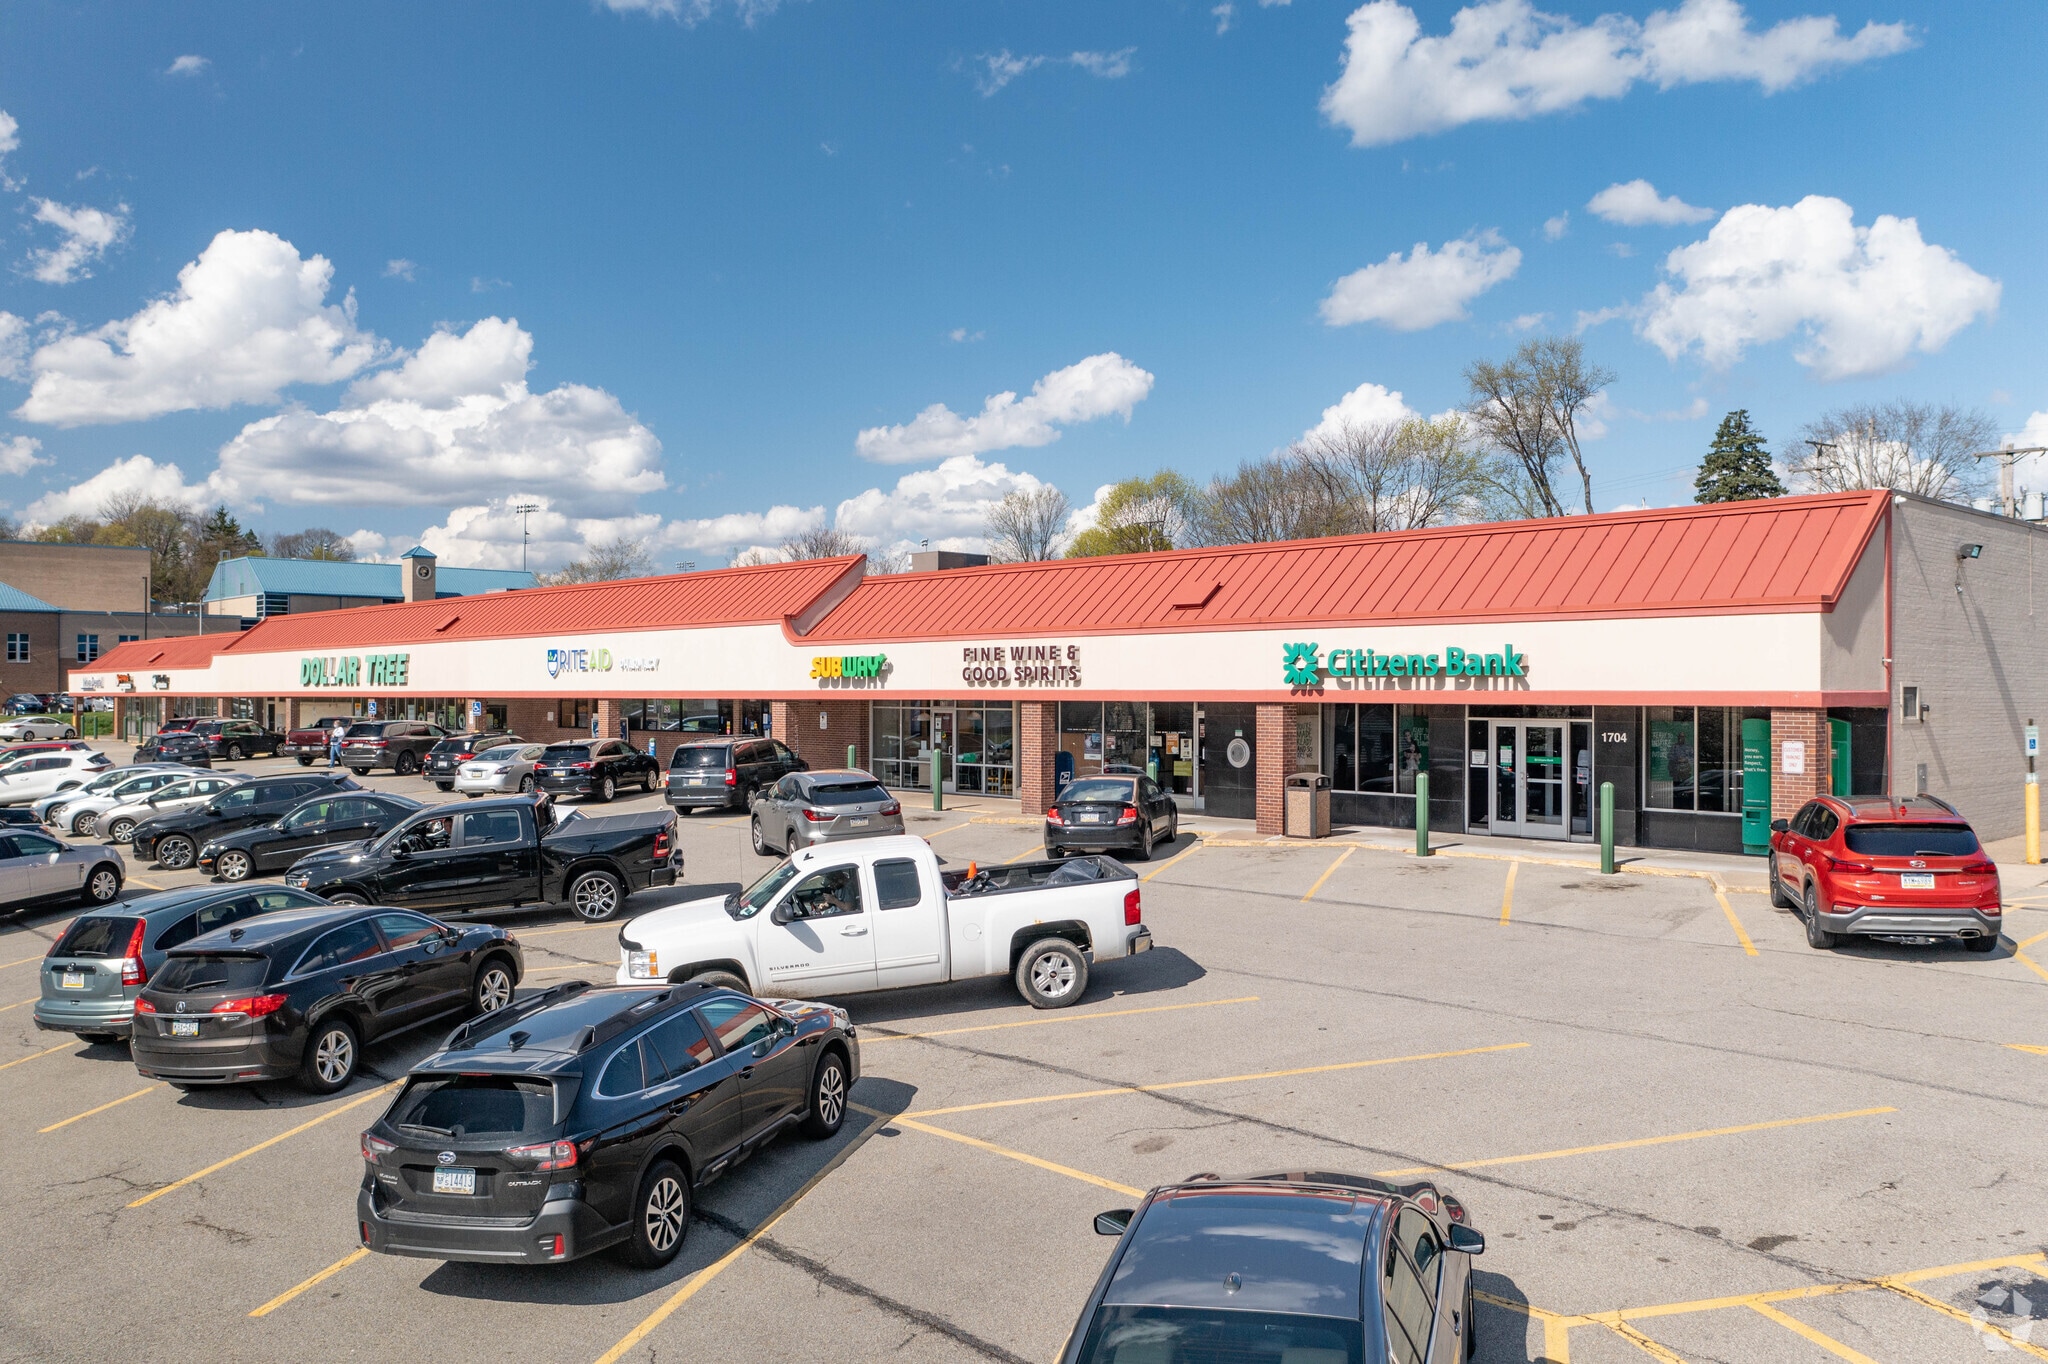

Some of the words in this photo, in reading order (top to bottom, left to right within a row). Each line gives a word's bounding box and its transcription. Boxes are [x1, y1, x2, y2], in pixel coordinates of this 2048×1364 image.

[560, 649, 586, 670] RITE
[590, 648, 612, 671] AID
[963, 647, 1001, 662] FINE
[1010, 645, 1057, 661] WINE
[1066, 644, 1076, 661] &
[1327, 648, 1441, 677] Citizens
[1446, 643, 1525, 677] Bank
[300, 656, 360, 686] DOLLAR
[365, 653, 408, 685] TREE
[809, 653, 887, 679] SUBWAY
[962, 666, 1007, 682] GOOD
[1014, 665, 1078, 681] SPIRITS
[1601, 732, 1627, 743] 1704
[769, 962, 810, 971] SILVERADO
[507, 1179, 542, 1188] OUTBACK
